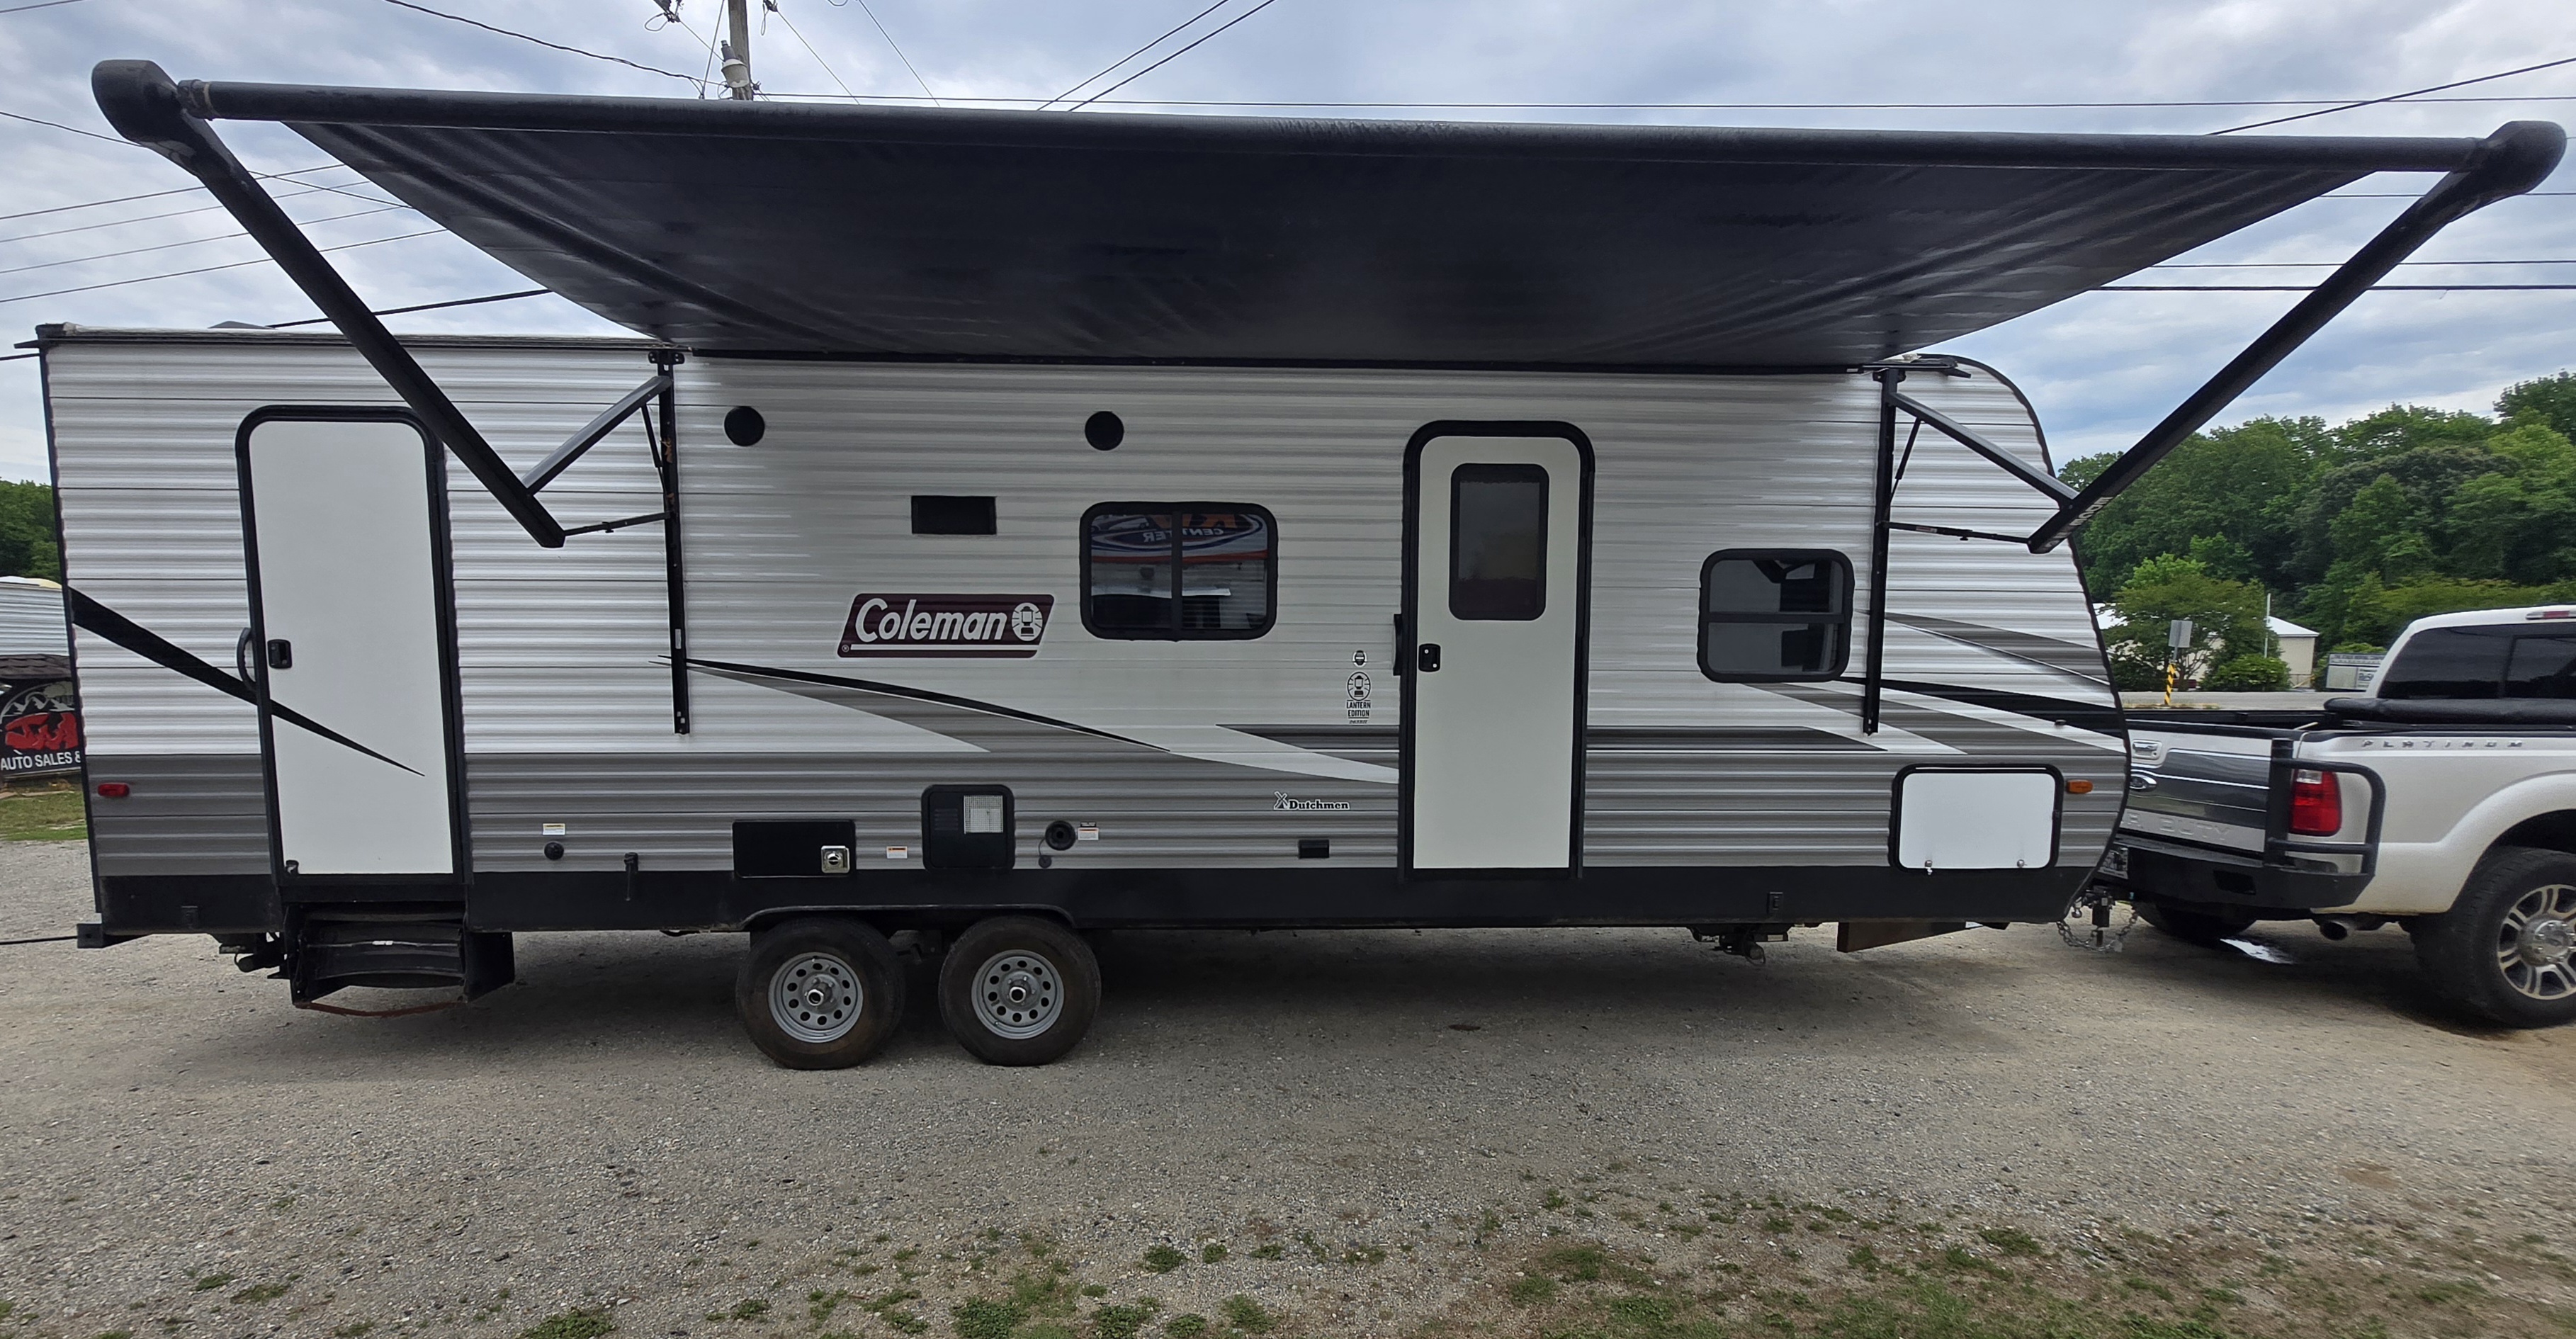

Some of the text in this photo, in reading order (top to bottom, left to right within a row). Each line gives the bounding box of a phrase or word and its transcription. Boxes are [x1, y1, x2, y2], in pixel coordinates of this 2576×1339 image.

[855, 598, 1007, 643] Coleman
[2361, 740, 2523, 748] PLATINUM
[0, 755, 33, 771] AUTO
[34, 751, 73, 767] SALES
[1289, 799, 1350, 810] Dutchmen
[2159, 816, 2232, 841] DUTY
